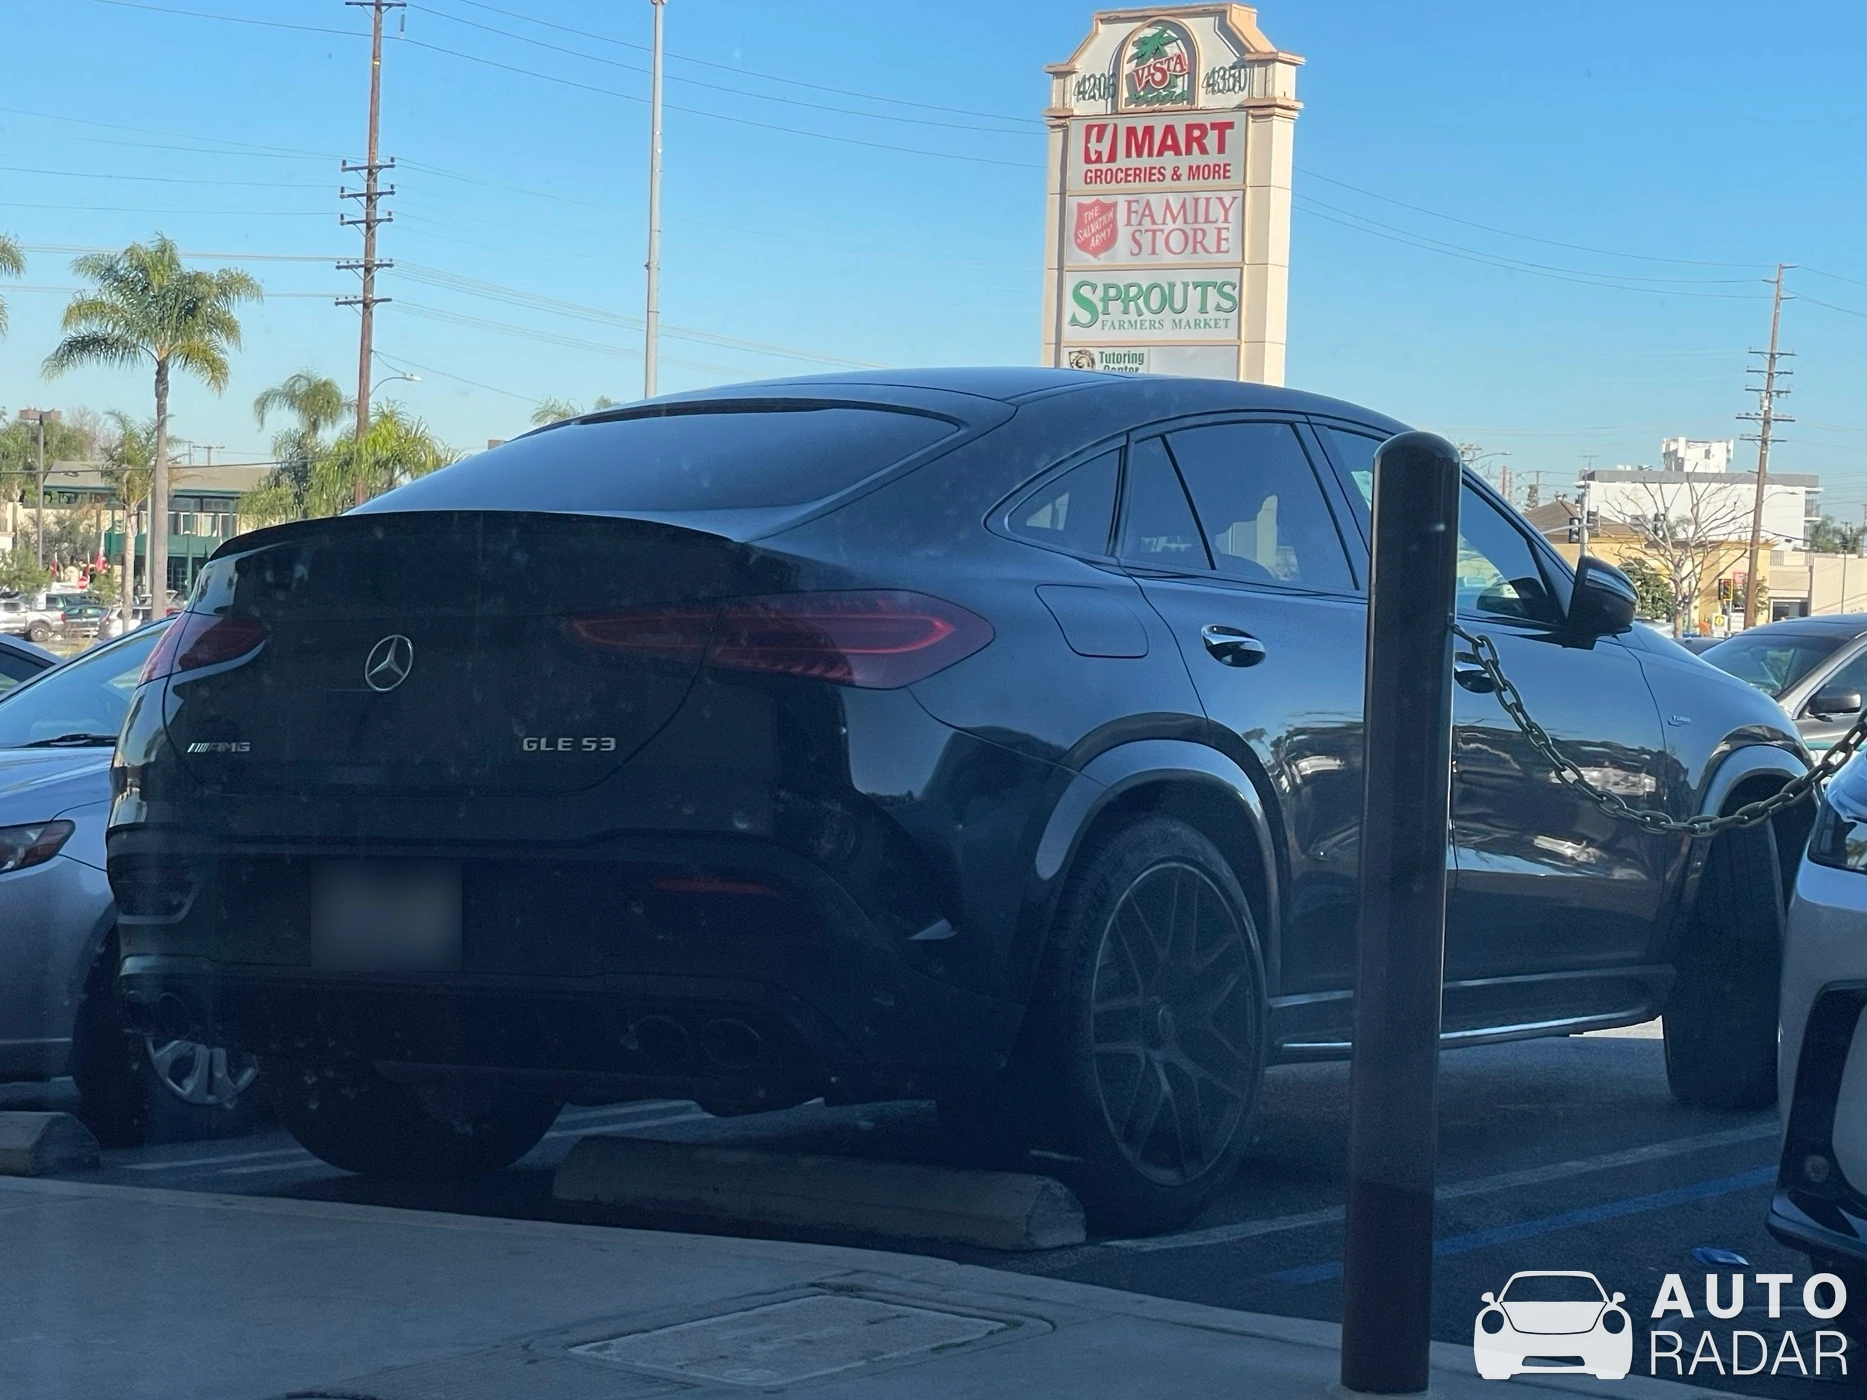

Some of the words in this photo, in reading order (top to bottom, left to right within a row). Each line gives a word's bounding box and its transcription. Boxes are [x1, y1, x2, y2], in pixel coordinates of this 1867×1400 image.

[1133, 53, 1187, 90] VISTA
[1125, 121, 1235, 158] MART
[1084, 166, 1166, 185] GROCERIES
[1171, 165, 1182, 181] &
[1187, 163, 1231, 181] MORE
[1077, 206, 1114, 244] SALVATION
[1084, 205, 1100, 224] THE
[1124, 197, 1239, 226] FAMILY
[1090, 224, 1113, 250] ARMY
[1130, 227, 1230, 256] STORE
[1068, 280, 1238, 328] SPROUTS
[1101, 319, 1164, 331] FARMERS
[1171, 318, 1231, 330] MARKET
[1099, 350, 1144, 365] Tutoring
[523, 737, 574, 751] GLE
[581, 737, 616, 751] 53
